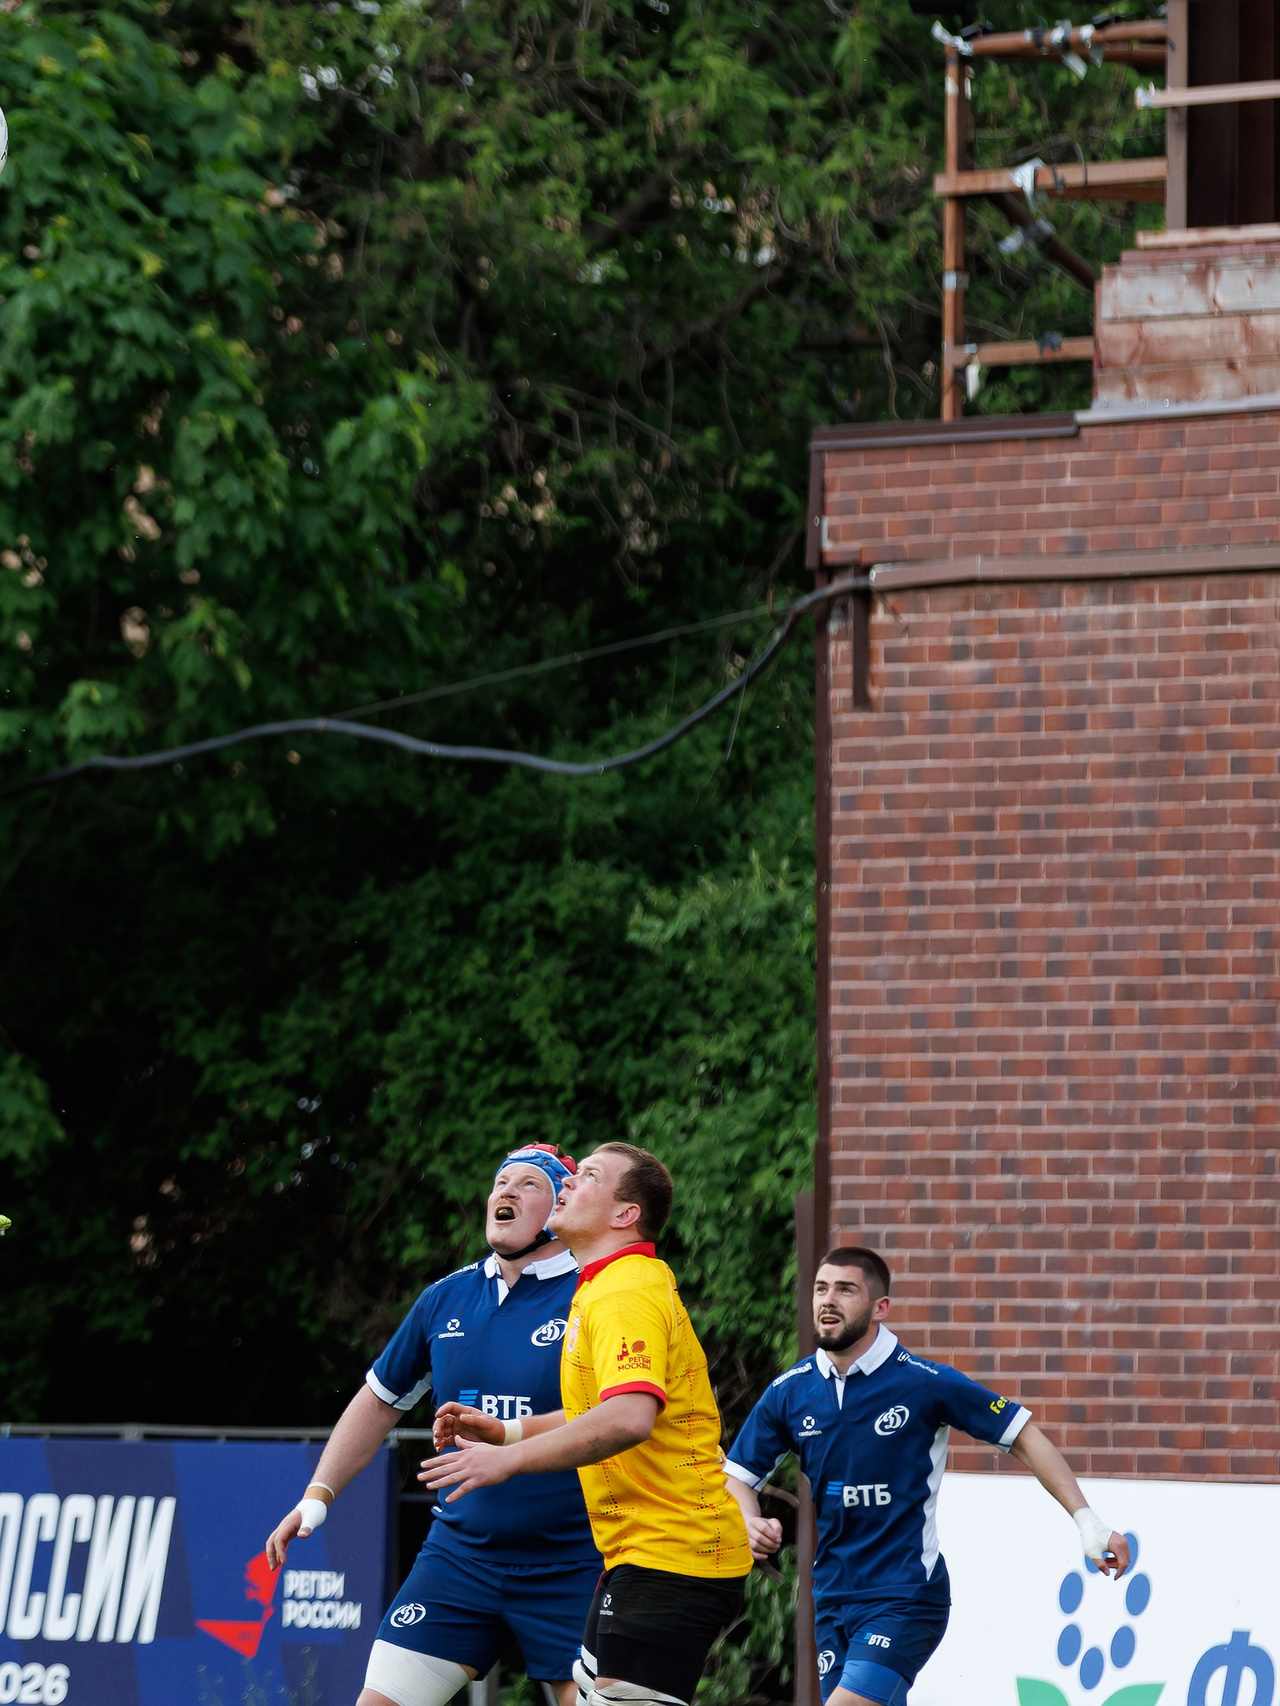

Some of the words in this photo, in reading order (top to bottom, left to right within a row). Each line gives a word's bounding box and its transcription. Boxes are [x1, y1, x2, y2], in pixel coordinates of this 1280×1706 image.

[481, 1395, 533, 1420] ВТБ
[843, 1484, 892, 1508] ВТБ
[283, 1569, 346, 1600] РЕГБИ
[281, 1599, 363, 1630] РОССИИ
[868, 1634, 892, 1649] ВТБ
